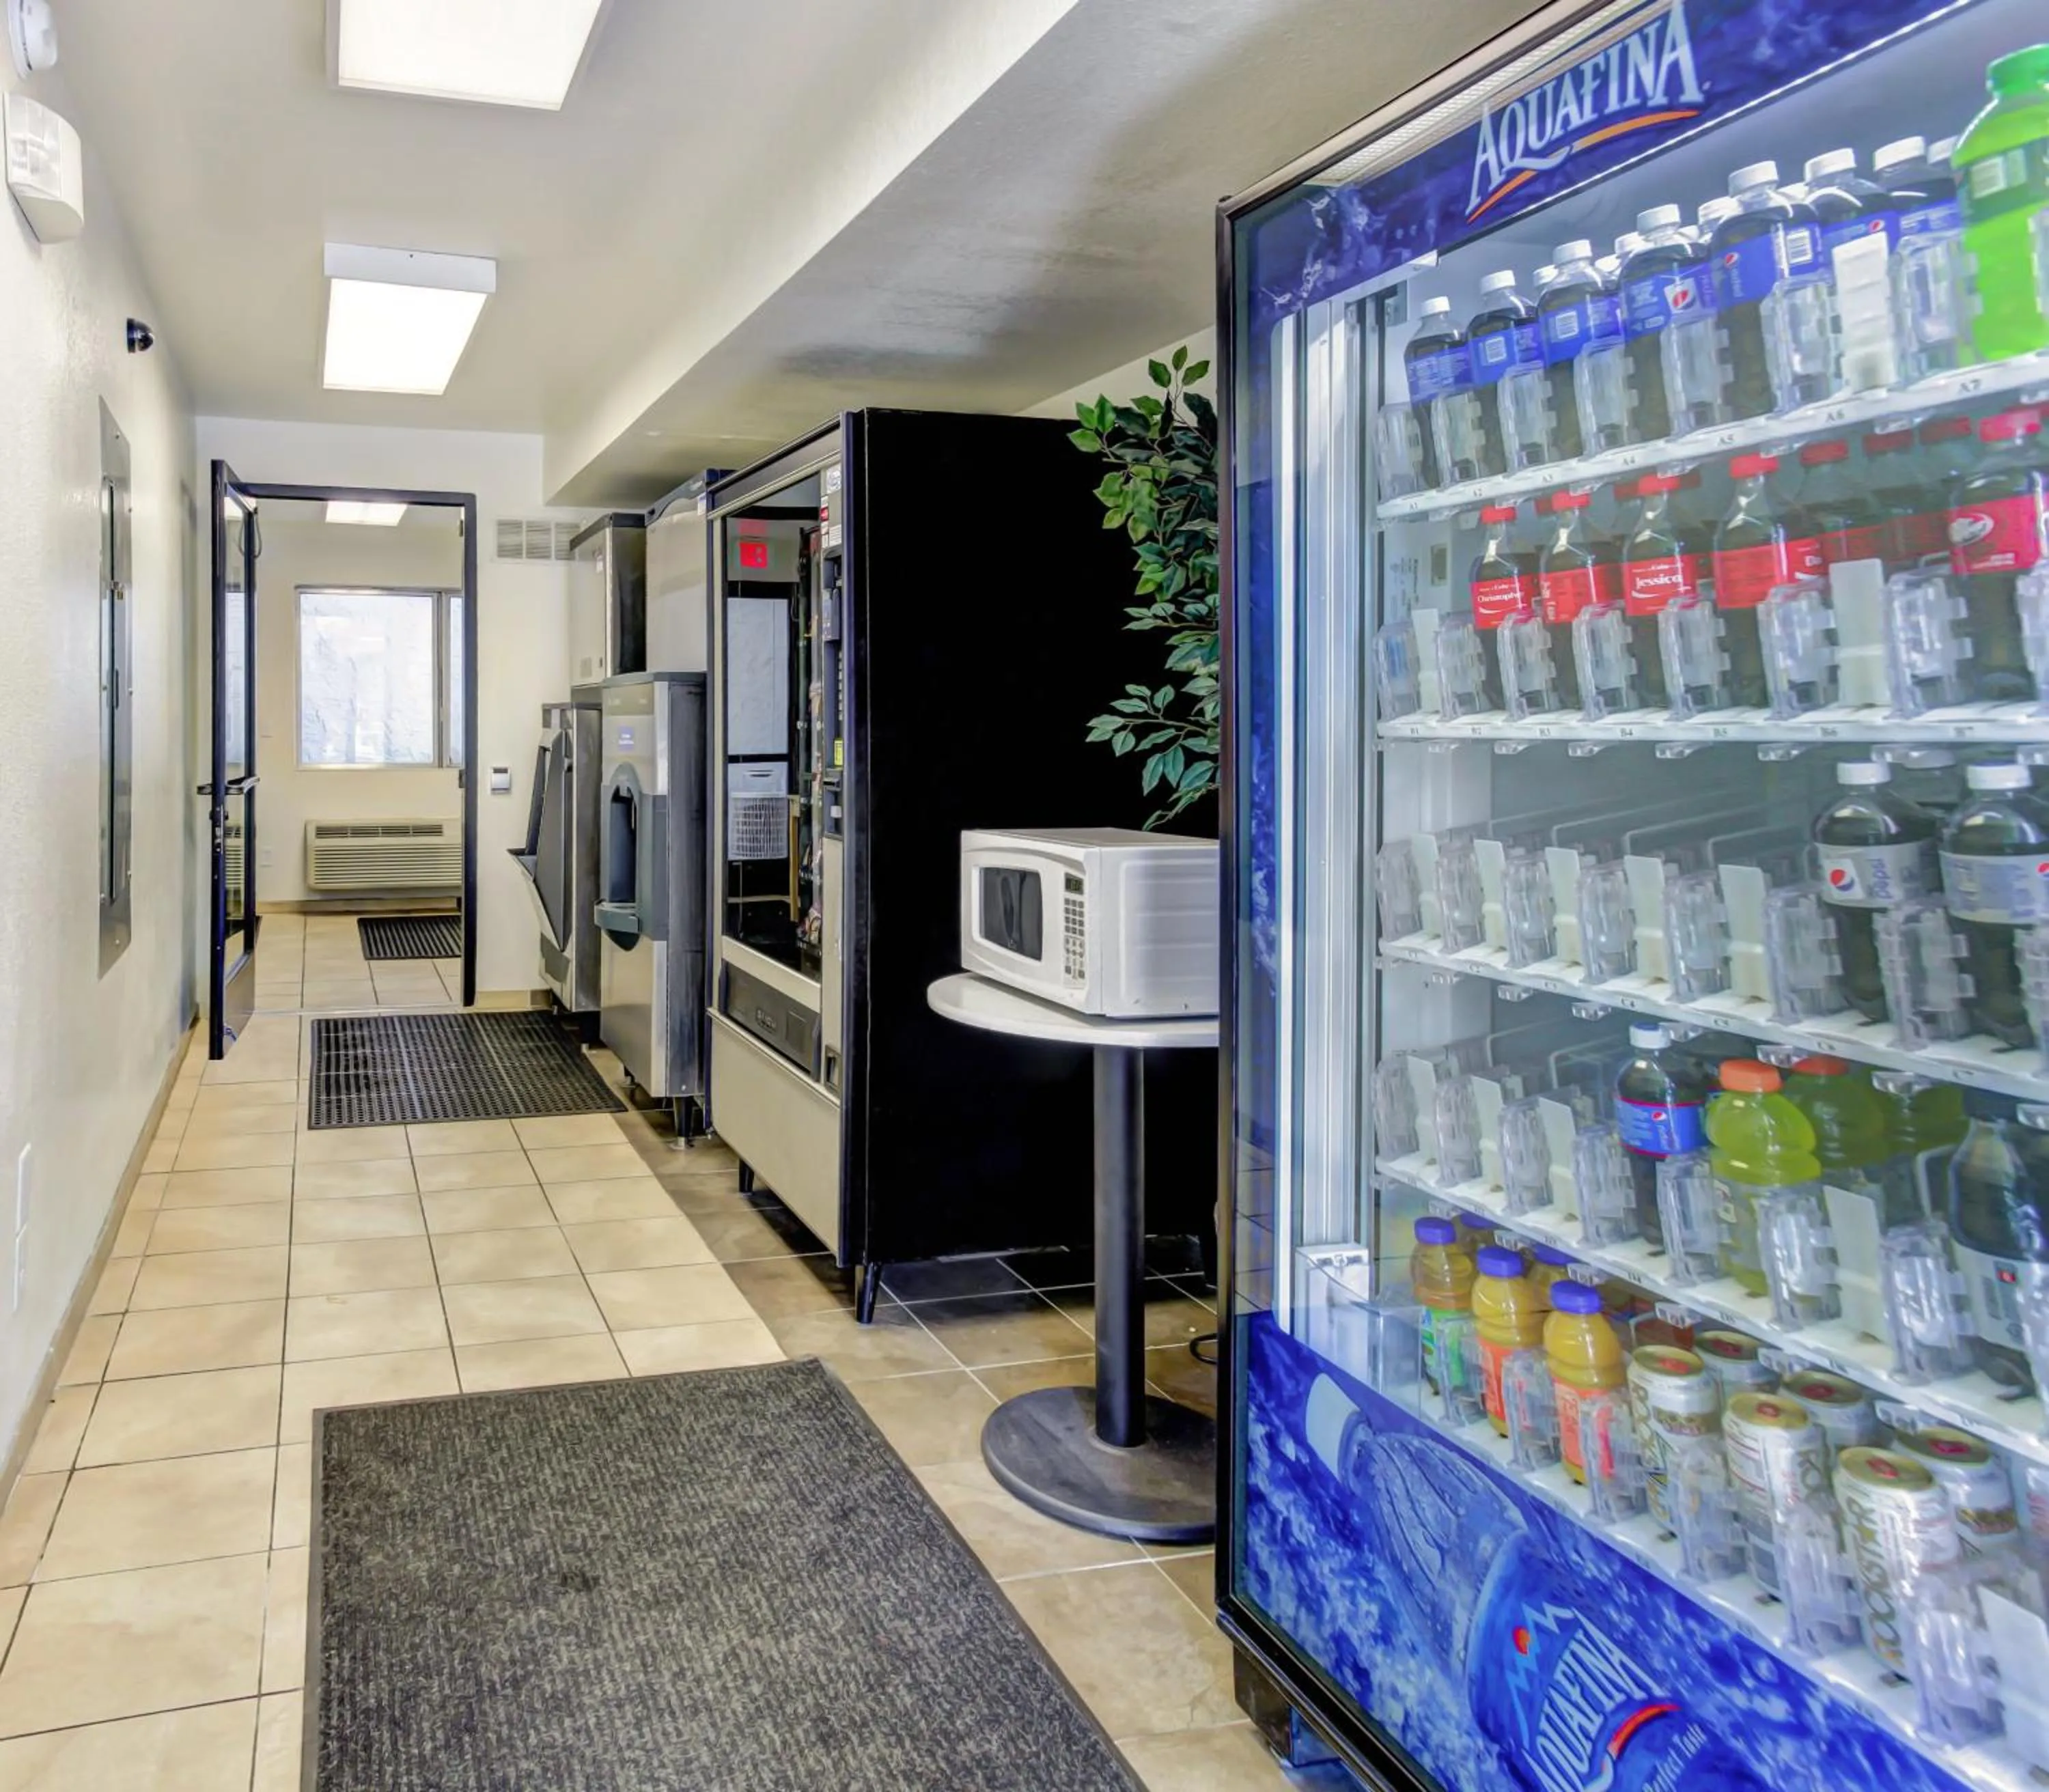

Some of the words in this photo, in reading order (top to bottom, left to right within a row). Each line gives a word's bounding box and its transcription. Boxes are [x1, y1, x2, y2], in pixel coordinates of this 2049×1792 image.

[1465, 0, 1705, 216] AQUAFINA
[1959, 380, 1982, 394] A7
[1635, 574, 1683, 589] Jessica
